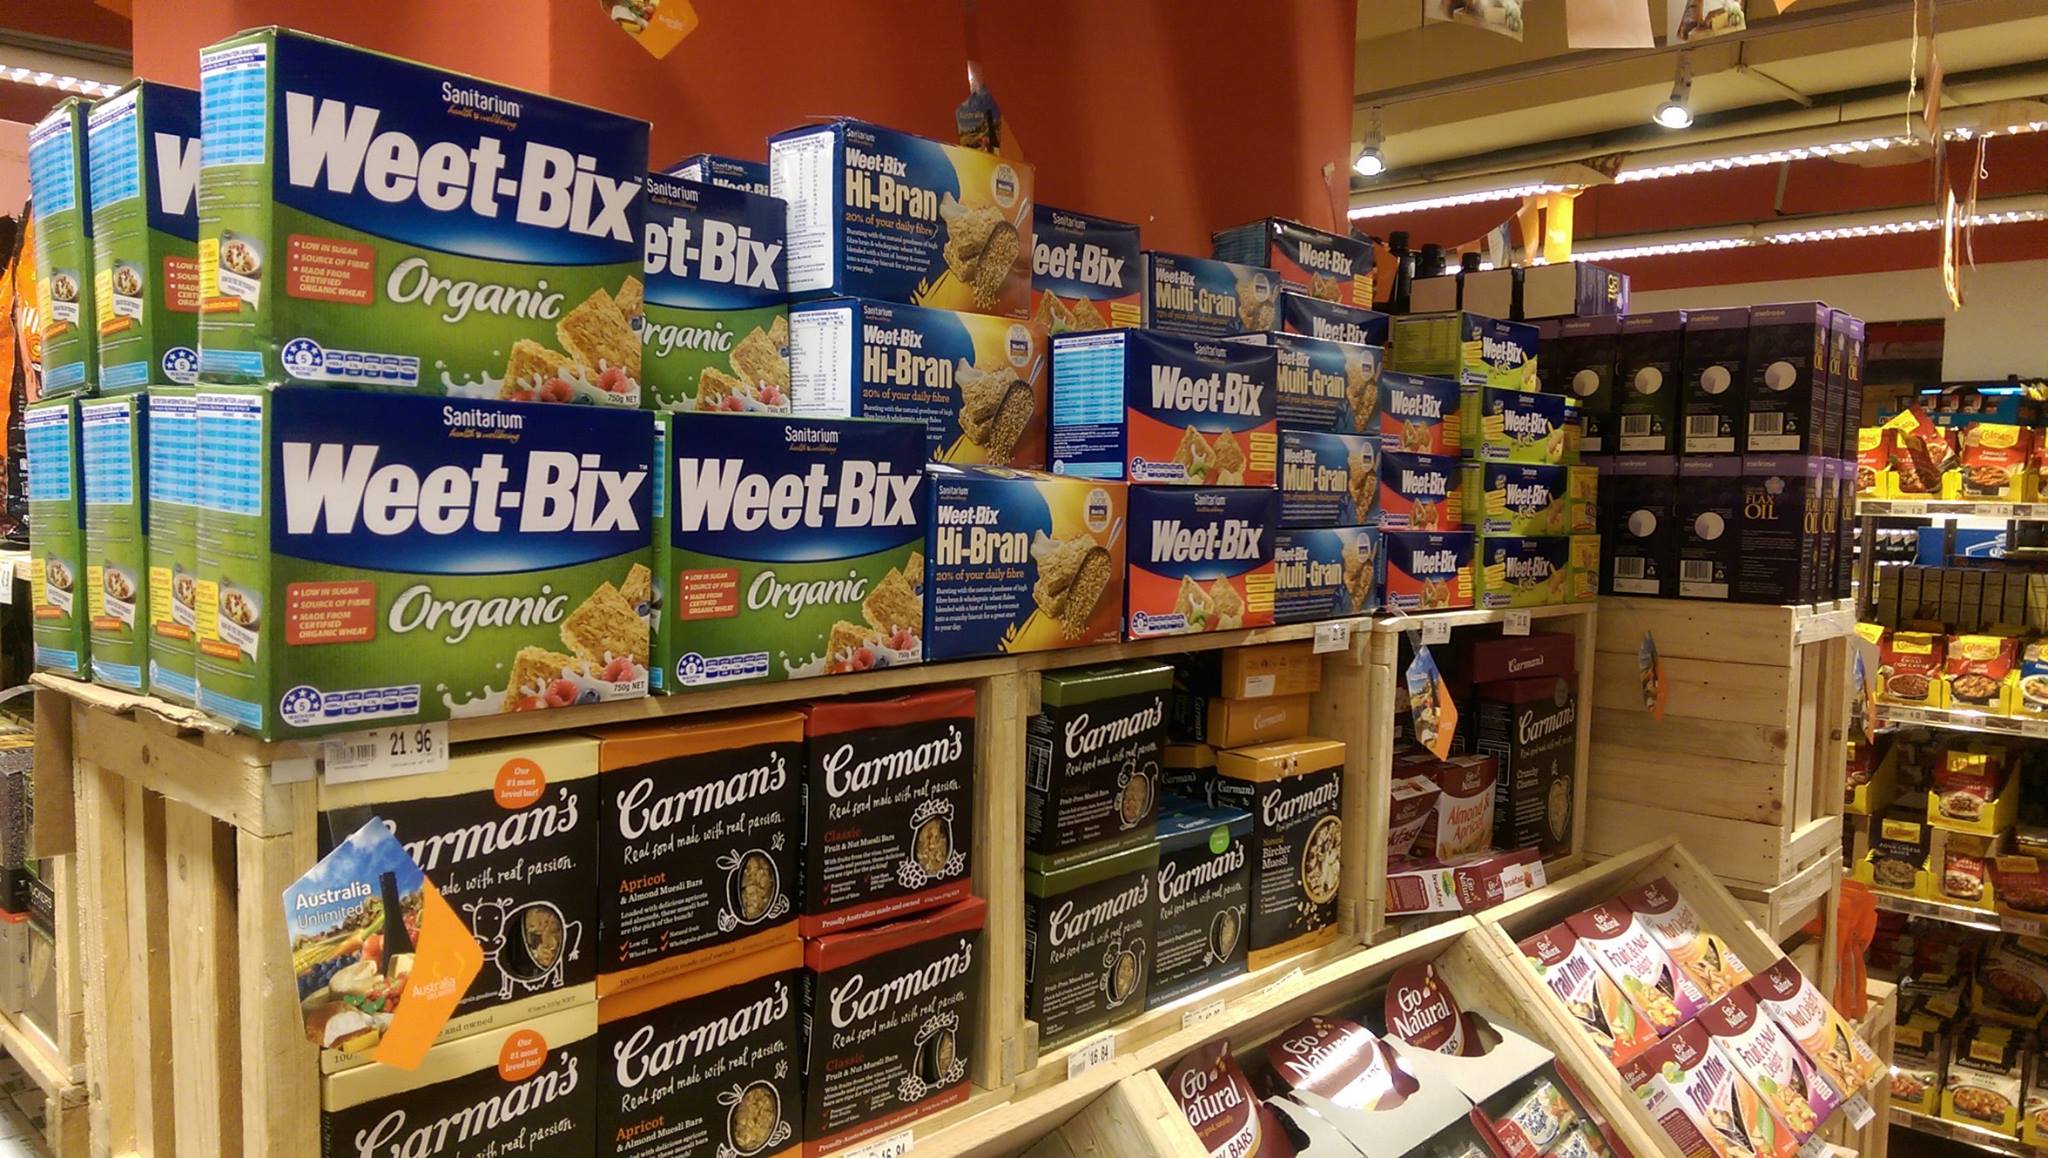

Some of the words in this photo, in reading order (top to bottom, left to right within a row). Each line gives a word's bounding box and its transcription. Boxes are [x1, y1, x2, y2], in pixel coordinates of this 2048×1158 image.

[442, 81, 520, 118] Sanitarium
[846, 128, 876, 143] Sanitarium
[285, 91, 642, 242] Weet-Bix
[845, 147, 907, 178] Weet-Bix
[647, 178, 699, 202] Sanitarium
[846, 168, 937, 222] Hi-Bran
[845, 212, 864, 224] 20%
[865, 214, 875, 226] of
[875, 218, 895, 234] your
[895, 219, 915, 236] daily
[1052, 211, 1087, 231] Sanitarium
[301, 241, 320, 250] LOW
[322, 243, 330, 251] IN
[331, 244, 358, 256] SUGAR
[301, 253, 334, 265] SOURCE
[335, 258, 347, 266] OF
[347, 259, 370, 269] FIBRE
[1299, 241, 1353, 276] Weet-Bix
[299, 275, 341, 287] CERTIFIED
[300, 266, 324, 277] MADE
[325, 268, 350, 279] FROM
[1155, 266, 1196, 286] Weet-Bix
[299, 283, 337, 295] ORGANIC
[338, 287, 368, 298] WHEAT
[386, 257, 565, 323] Organic
[1156, 284, 1237, 318] Multi-Grain
[863, 305, 893, 318] Sanitarium
[863, 324, 924, 349] Weet-Bix
[1312, 317, 1369, 345] Weet-Bix
[1193, 341, 1228, 358] Sanitarium
[1482, 336, 1523, 364] Weet-Bix
[863, 345, 952, 389] Hi-Bran
[1151, 364, 1264, 417] Weet-Bix
[1277, 364, 1345, 399] Multi-Grain
[863, 389, 880, 398] 20%
[881, 387, 892, 399] of
[892, 392, 911, 401] your
[911, 390, 931, 403] daily
[932, 392, 950, 403] fibre
[1391, 390, 1442, 418] Weet-Bix
[443, 405, 523, 429] Sanitarium
[1504, 409, 1548, 434] Weet-Bix
[785, 425, 839, 443] Sanitarium
[1283, 449, 1318, 465] Weet-Bix
[282, 442, 648, 535] Weet-Bix
[938, 485, 969, 496] Sanitarium
[1282, 463, 1348, 492] Multi-Grain
[1401, 469, 1447, 495] Weet-Bix
[679, 458, 922, 532] Weet-Bix
[1507, 484, 1549, 506] Weet-Bix
[1746, 494, 1774, 504] FLAX
[937, 505, 1000, 525] Weet-Bix
[1744, 504, 1778, 520] OIL
[937, 526, 1028, 566] Hi-Bran
[1151, 519, 1264, 562] Weet-Bix
[1412, 549, 1457, 574] Weet-Bix
[1506, 557, 1550, 578] Weet-Bix
[936, 572, 954, 581] 20%
[955, 569, 965, 579] of
[965, 572, 985, 582] your
[985, 568, 1006, 581] daily
[1006, 568, 1025, 579] fibre
[1274, 560, 1342, 590] Multi-Grain
[300, 587, 320, 597] LOW
[322, 587, 331, 596] IN
[332, 586, 359, 596] SUGAR
[300, 600, 334, 609] SOURCE
[335, 600, 346, 608] OF
[347, 598, 371, 607] FIBRE
[747, 570, 869, 619] Organic
[299, 612, 325, 622] MADE
[326, 611, 351, 620] FROM
[299, 620, 342, 629] CERTIFIED
[389, 584, 569, 644] Organic
[298, 628, 337, 639] ORGANIC
[338, 626, 368, 637] WHEAT
[1508, 655, 1544, 673] Carman's
[614, 682, 630, 693] 750g
[631, 681, 644, 689] NET
[1065, 696, 1163, 759] Carman's
[1254, 711, 1286, 730] Carman's
[1519, 698, 1575, 745] Carman's
[390, 728, 432, 757] 21.96
[514, 767, 530, 775] Our
[823, 724, 962, 799] Carman's
[501, 790, 521, 798] loved
[516, 778, 536, 786] most
[616, 751, 786, 840] Carman's
[829, 802, 851, 820] Real
[852, 794, 872, 817] food
[1262, 773, 1340, 827] Carman's
[1448, 803, 1483, 825] Almond
[624, 844, 650, 865] Real
[652, 833, 675, 860] food
[677, 824, 701, 848] made
[703, 820, 725, 841] with
[726, 812, 746, 836] real
[748, 810, 785, 836] passion.
[823, 843, 841, 854] Fruit
[848, 839, 860, 849] Nut
[1262, 843, 1292, 859] Bircher
[466, 870, 494, 892] with
[497, 858, 523, 883] real
[527, 854, 577, 886] passion.
[619, 872, 667, 893] Apricot
[1158, 840, 1245, 904] Carman's
[296, 881, 372, 910] Australia
[628, 889, 659, 904] Almond
[660, 881, 686, 895] Muesli
[686, 878, 703, 889] Bars
[297, 900, 365, 929] Unlimited
[1049, 874, 1150, 946] Carman's
[1604, 944, 1629, 969] Fruit
[412, 976, 456, 998] Australia
[830, 938, 972, 1028] Carman's
[1548, 966, 1572, 1001] Trail
[1568, 955, 1591, 985] Mix
[1398, 987, 1422, 1013] Go
[1393, 993, 1451, 1040] Natural
[517, 1038, 532, 1047] Our
[614, 980, 789, 1088] Carman's
[832, 1031, 855, 1050] Real
[856, 1021, 877, 1044] food
[1283, 1034, 1320, 1056] Go
[1284, 1027, 1353, 1079] Natural
[1736, 1034, 1762, 1067] Fruit
[505, 1060, 525, 1073] loved
[622, 1092, 648, 1113] Real
[651, 1076, 674, 1105] food
[677, 1065, 701, 1090] made
[705, 1058, 726, 1080] with
[729, 1046, 749, 1071] real
[1181, 1068, 1207, 1100] Go
[1686, 1070, 1709, 1114] Trail
[1706, 1054, 1727, 1087] Mix
[355, 1051, 580, 1158] Carman's
[501, 1127, 527, 1152] real
[529, 1116, 577, 1145] passion.
[615, 1115, 665, 1142] Apricot
[625, 1133, 656, 1151] Almond
[685, 1116, 703, 1129] Bars
